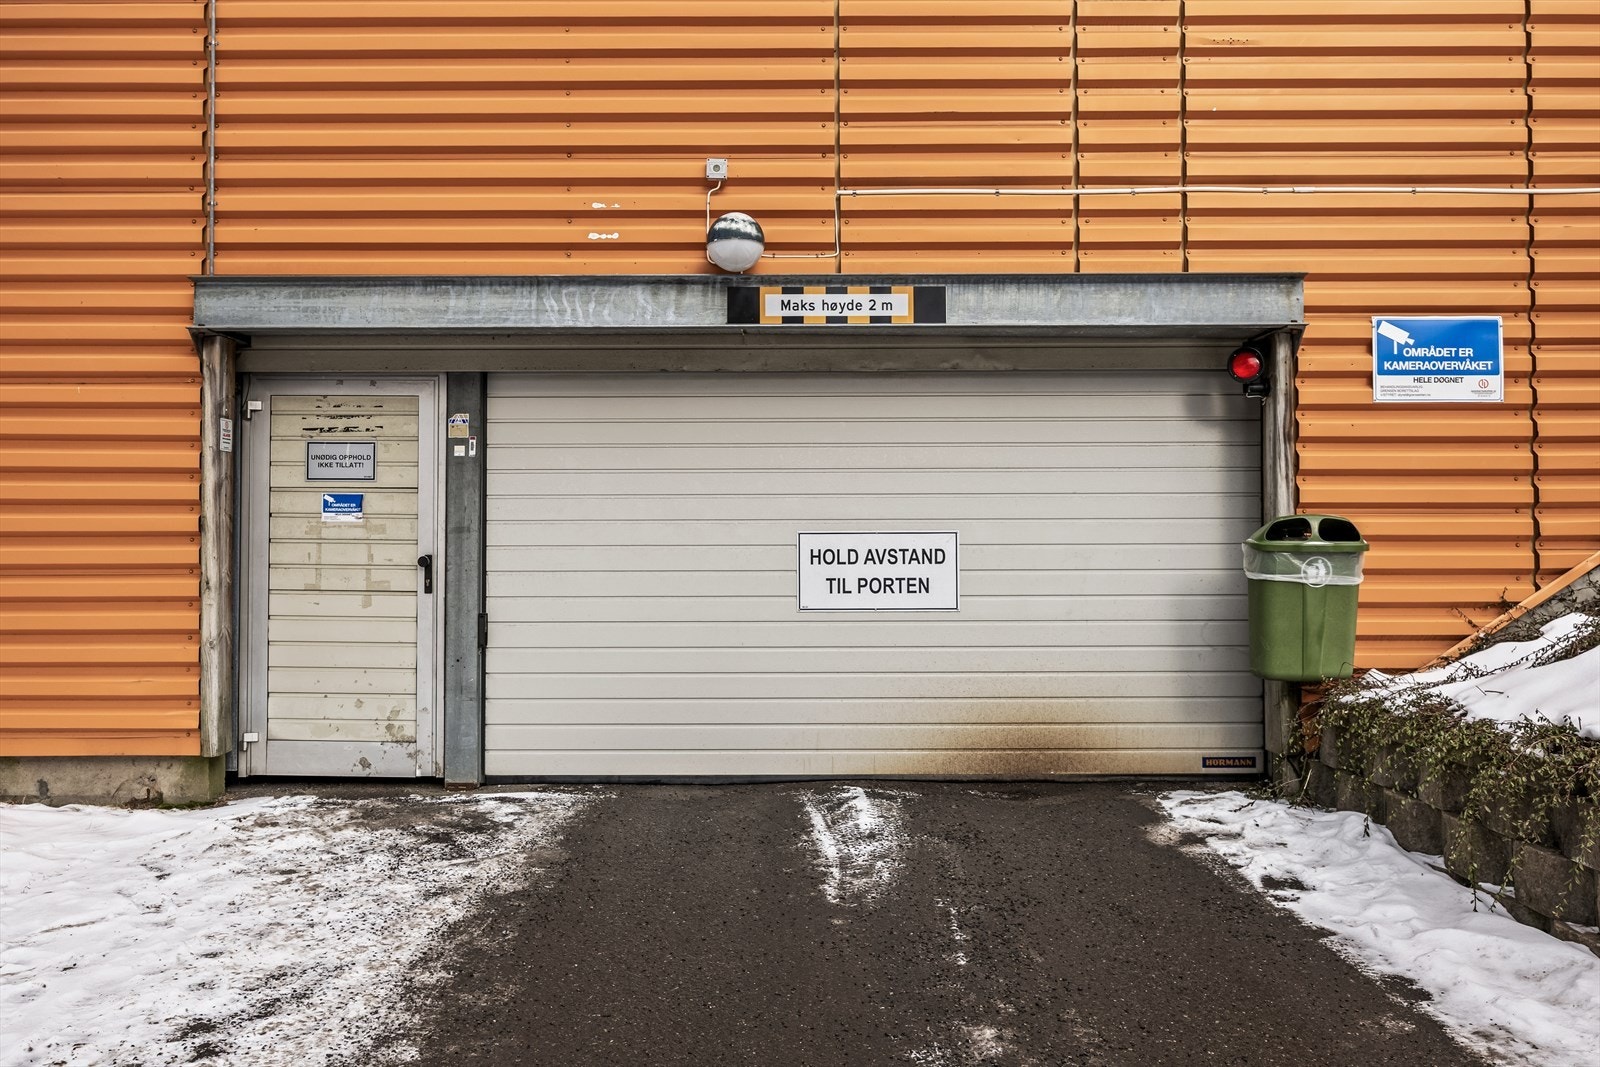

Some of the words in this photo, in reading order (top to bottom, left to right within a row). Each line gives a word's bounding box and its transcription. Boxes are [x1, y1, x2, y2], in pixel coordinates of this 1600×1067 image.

[780, 299, 816, 312] Maks
[822, 299, 863, 315] høyde
[868, 299, 877, 312] 2
[881, 301, 893, 312] m
[1403, 345, 1457, 358] OMRÅDET
[1458, 347, 1474, 358] ER
[1384, 358, 1494, 371] KAMERAOVERVÅKET
[1412, 376, 1433, 384] HELE
[1433, 376, 1465, 384] DØGNET
[809, 548, 860, 565] HOLD
[863, 548, 947, 565] AVSTAND
[825, 577, 853, 594] TIL
[857, 577, 931, 594] PORTEN
